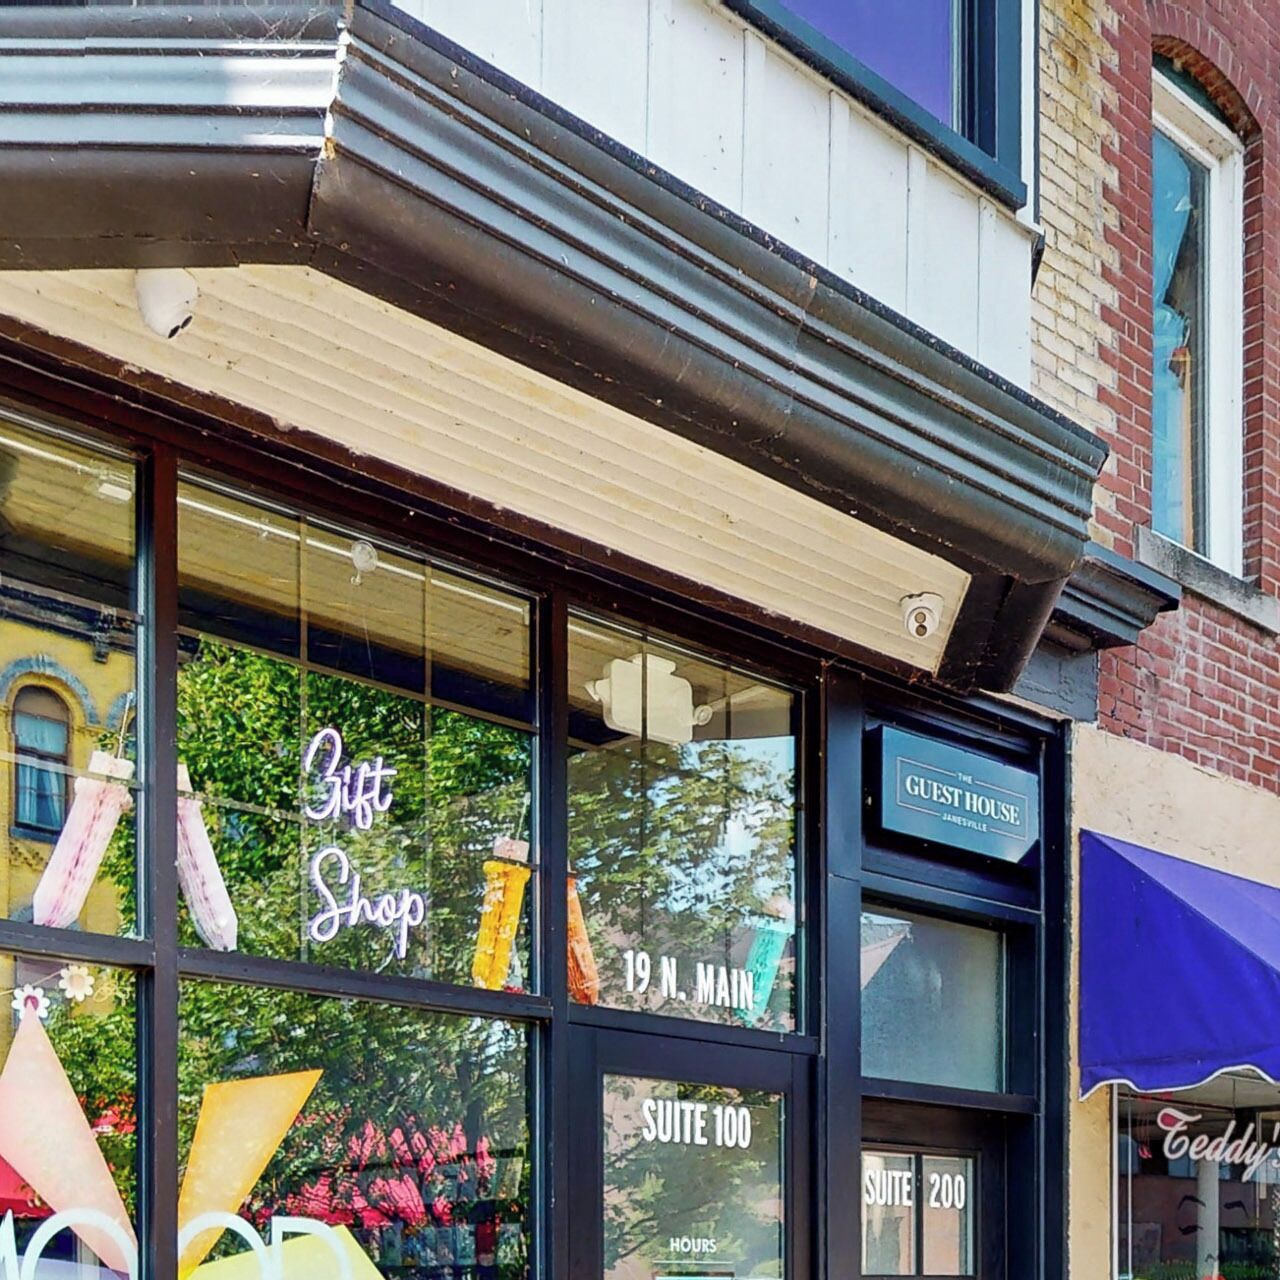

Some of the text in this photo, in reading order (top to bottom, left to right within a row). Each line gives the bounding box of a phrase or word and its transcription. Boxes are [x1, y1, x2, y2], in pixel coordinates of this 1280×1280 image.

[303, 727, 397, 830] Gift
[905, 775, 1020, 825] GUEST HOUSE
[957, 773, 973, 785] THE
[942, 813, 987, 832] JANESVILLE
[309, 847, 424, 959] Shop
[622, 950, 754, 1010] 19 N. MAIN
[642, 1099, 751, 1148] SUITE 100
[865, 1170, 965, 1210] SUITE 200
[670, 1235, 717, 1255] HOURS
